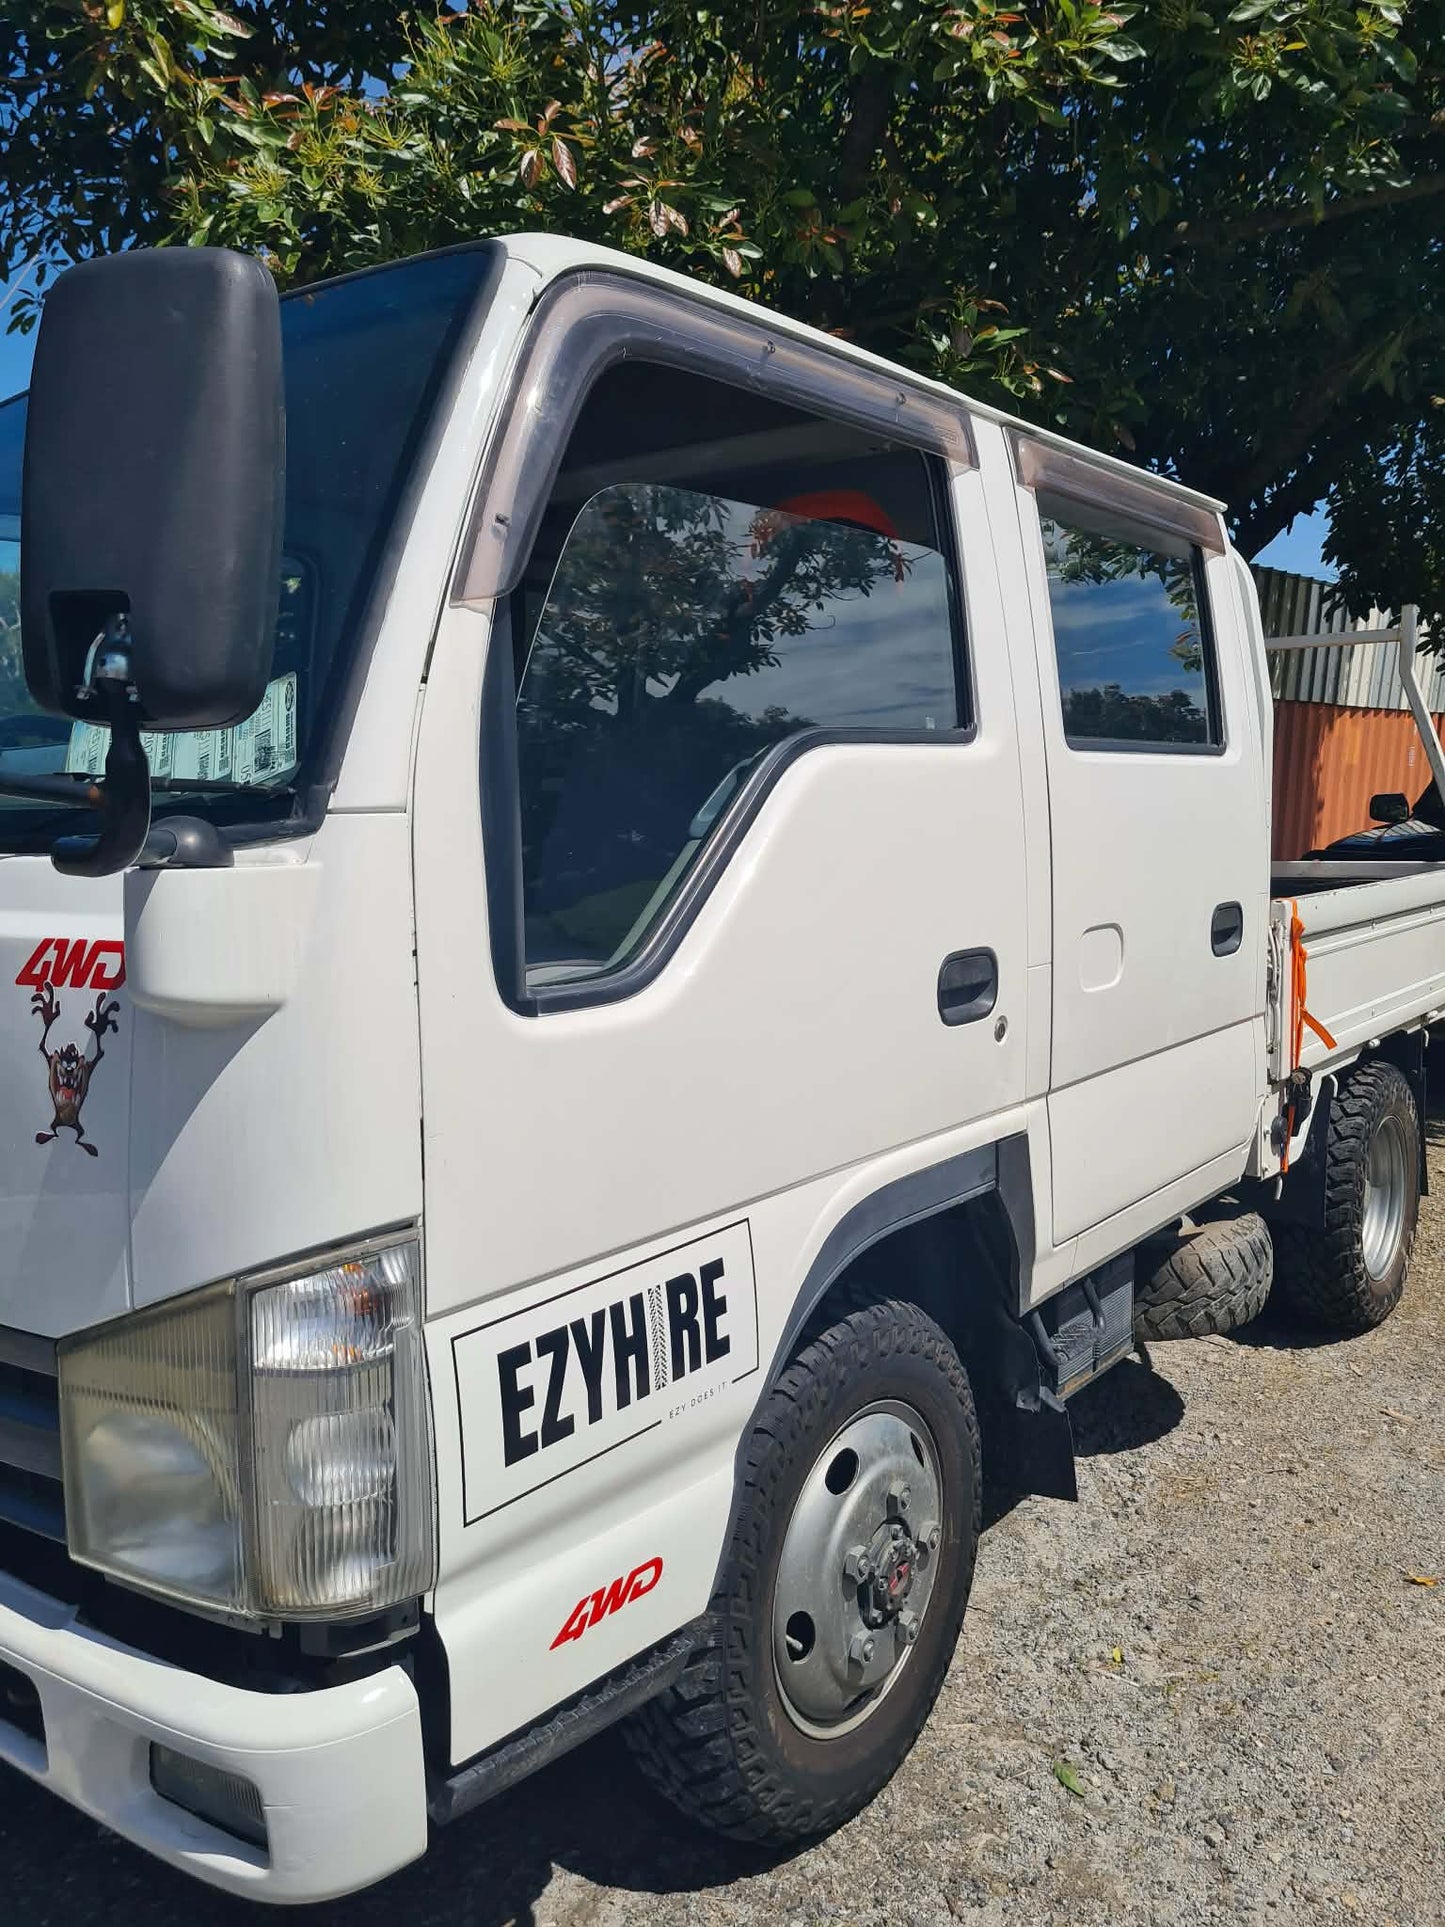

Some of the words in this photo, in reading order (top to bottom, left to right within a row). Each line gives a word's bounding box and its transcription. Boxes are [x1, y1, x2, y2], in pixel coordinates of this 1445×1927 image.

[15, 937, 126, 992] 4WD
[496, 1256, 731, 1468] EZYHIRE
[669, 1403, 686, 1419] EZY
[690, 1388, 714, 1407] DOES
[549, 1556, 664, 1651] 4WD
